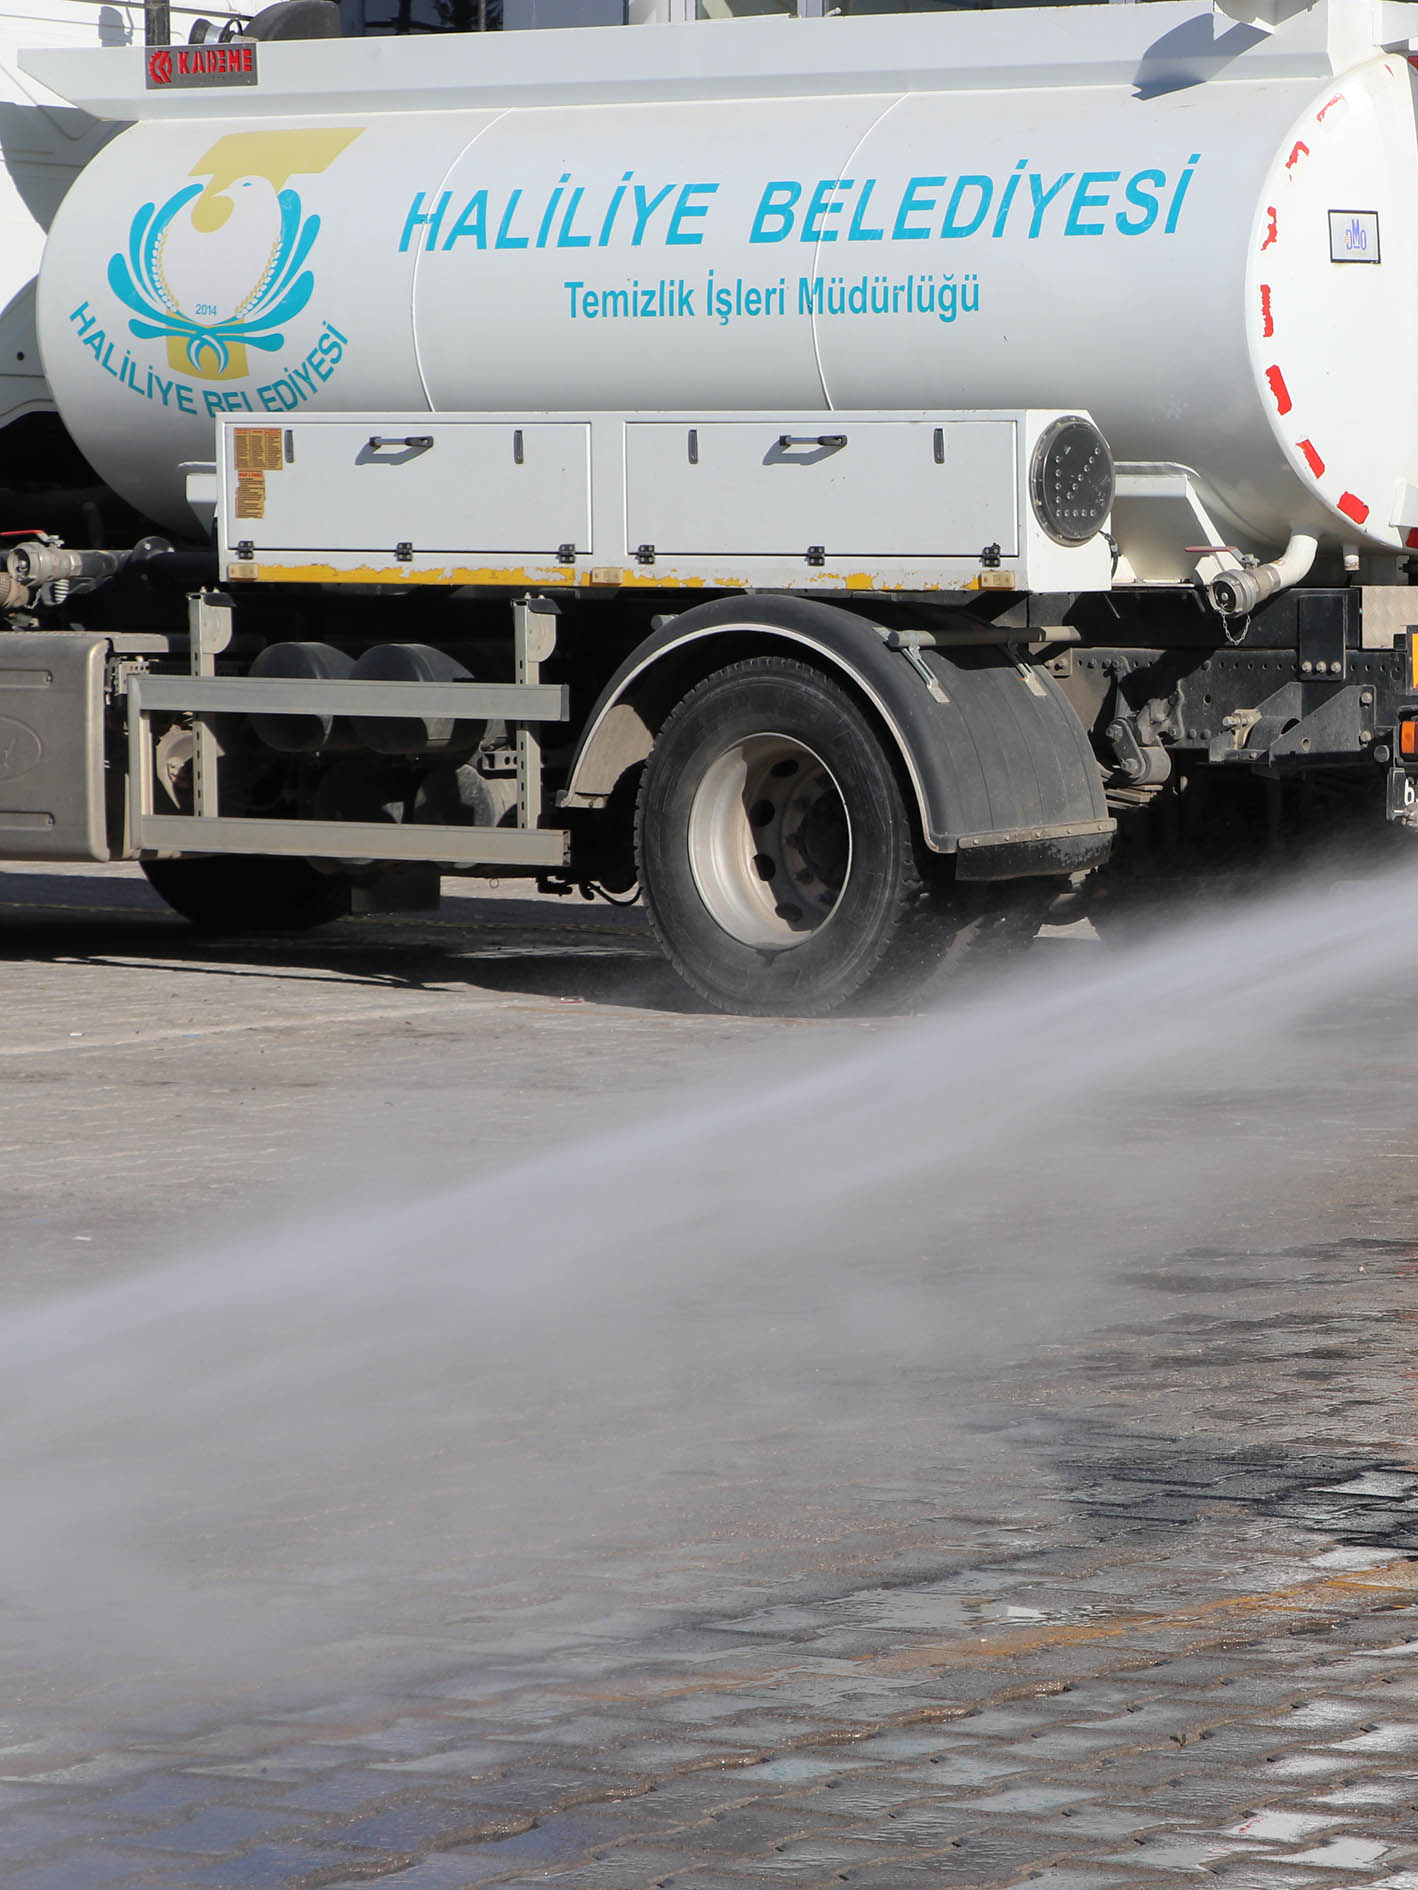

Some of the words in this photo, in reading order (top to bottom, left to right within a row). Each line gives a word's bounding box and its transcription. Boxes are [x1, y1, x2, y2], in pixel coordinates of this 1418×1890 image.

[177, 48, 253, 74] KADEME
[398, 171, 720, 253] HALİLİYE
[749, 153, 1201, 243] BELEDİYESİ
[195, 303, 217, 316] 2014
[564, 279, 695, 319] Temizlik
[706, 269, 785, 326] İşleri
[799, 273, 980, 323] Müdürlüğü
[69, 301, 197, 416] HALİLİYE
[202, 320, 348, 418] BELEDİYESİ
